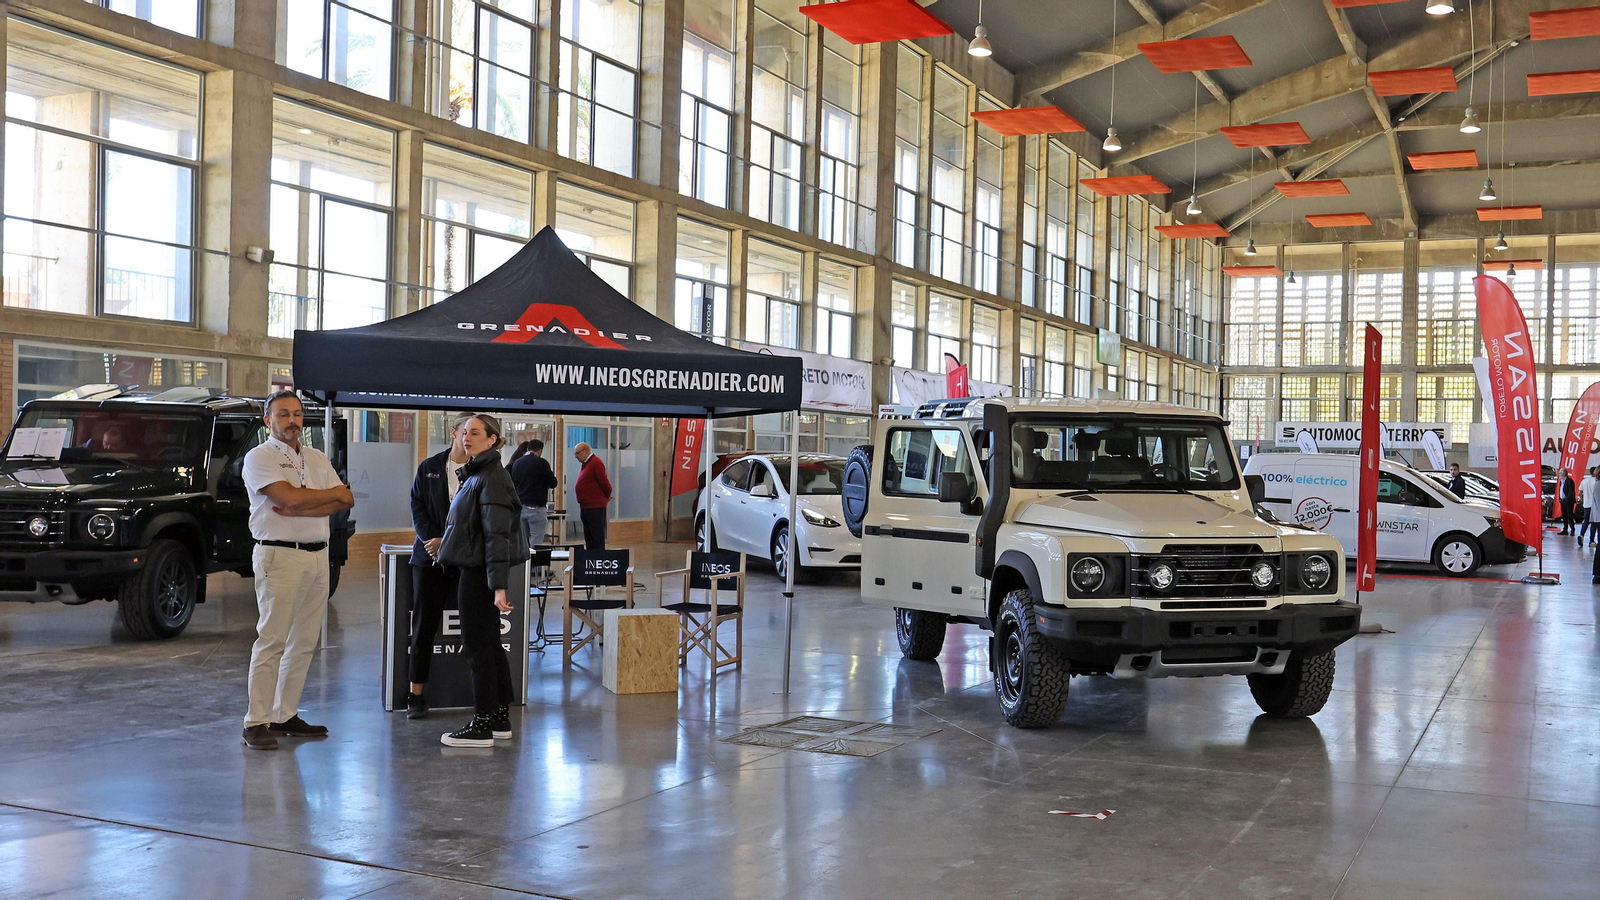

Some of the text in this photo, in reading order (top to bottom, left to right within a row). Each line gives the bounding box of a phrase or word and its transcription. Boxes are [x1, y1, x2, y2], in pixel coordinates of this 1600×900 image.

[457, 322, 653, 342] GRENADIER
[535, 363, 785, 394] WWW.INEOSGRENADIER.COM
[832, 371, 865, 390] MOTOR
[1564, 409, 1588, 476] ISSAN
[1262, 473, 1347, 487] 100% eléctrico
[1295, 504, 1333, 523] 12.000€
[585, 559, 619, 569] INEOS
[701, 562, 731, 574] INEOS
